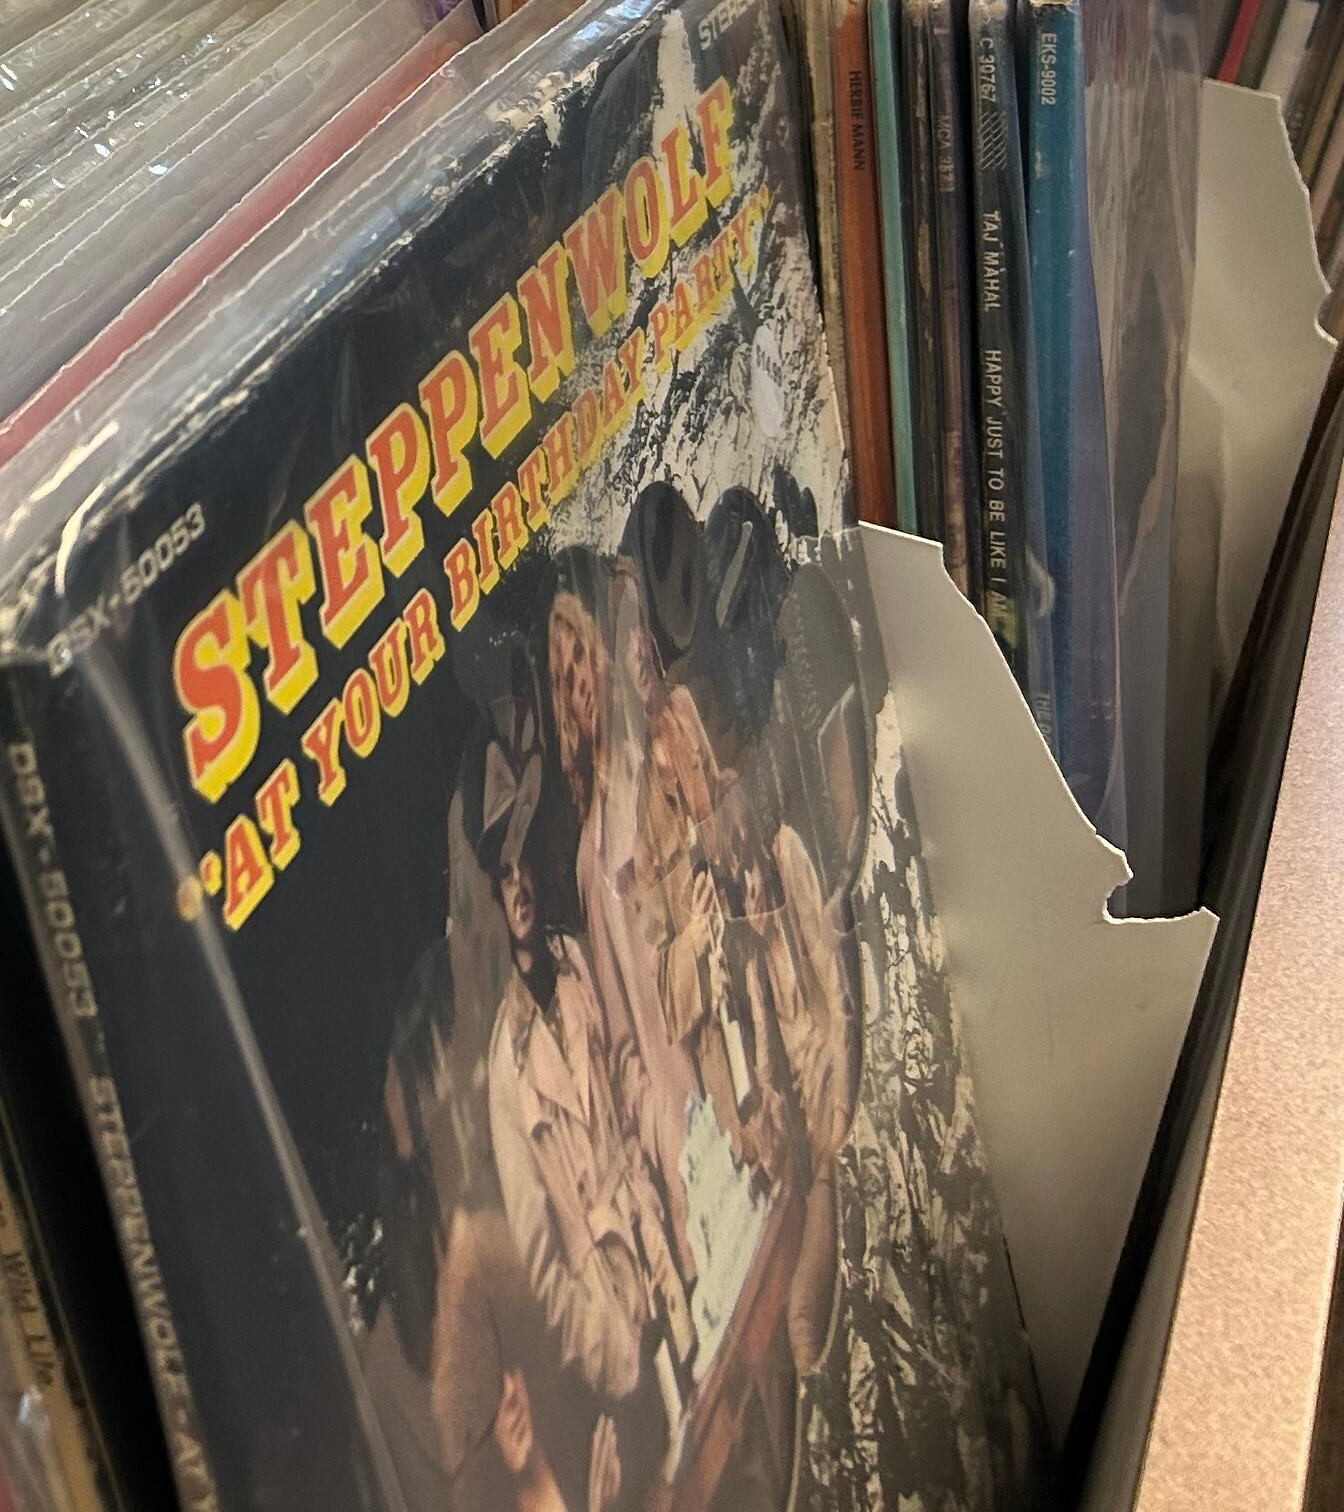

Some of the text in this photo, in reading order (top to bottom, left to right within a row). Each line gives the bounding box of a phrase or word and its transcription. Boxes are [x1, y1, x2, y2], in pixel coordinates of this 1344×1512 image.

[978, 37, 996, 103] C 30767
[1040, 32, 1057, 105] EKS-9002
[848, 70, 866, 171] HERBIE MANN
[982, 210, 1000, 242] TAJ
[982, 251, 1001, 312] MAHAL
[984, 349, 1002, 407] HAPPY
[174, 75, 737, 802] STEPPENWOLF
[986, 416, 1003, 459] JUST
[987, 467, 1005, 491] TO
[988, 499, 1005, 522] BE
[299, 587, 445, 804] YOUR
[442, 327, 646, 632] BIRTHDAY
[989, 530, 1007, 569] LIKE
[991, 590, 1008, 619] AM
[87, 1073, 192, 1403] STEPPENWOLF
